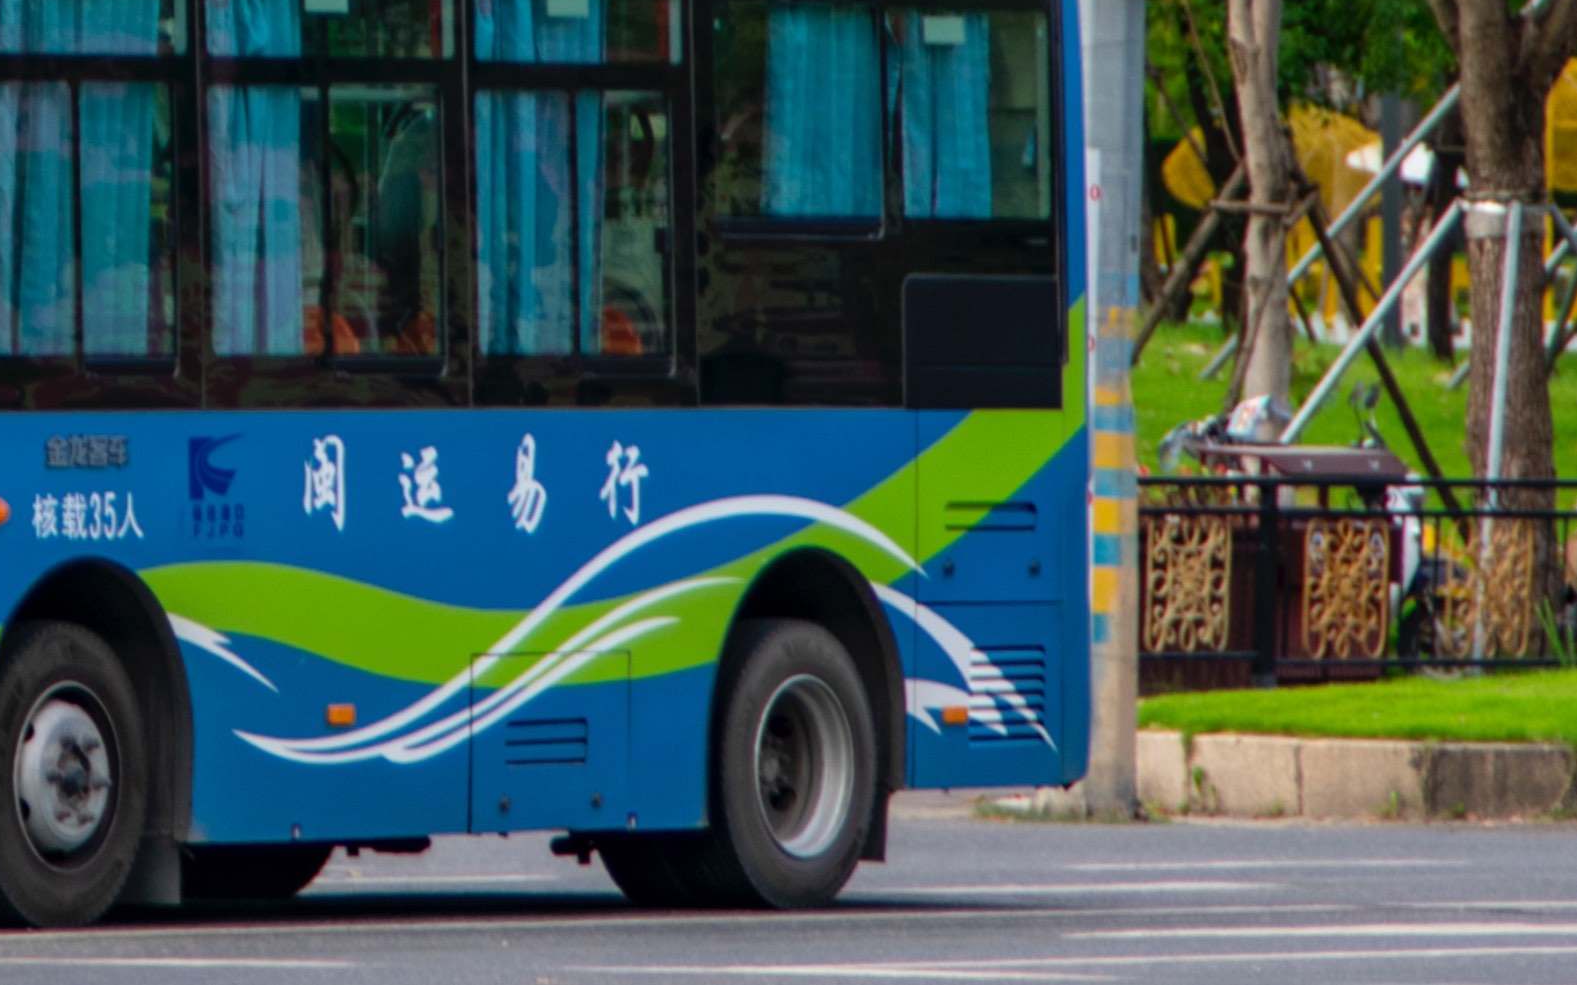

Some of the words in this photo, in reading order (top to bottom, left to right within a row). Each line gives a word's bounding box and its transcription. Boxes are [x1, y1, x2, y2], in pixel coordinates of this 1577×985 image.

[31, 491, 145, 540] 核载35人
[303, 432, 649, 534] 闽运易行
